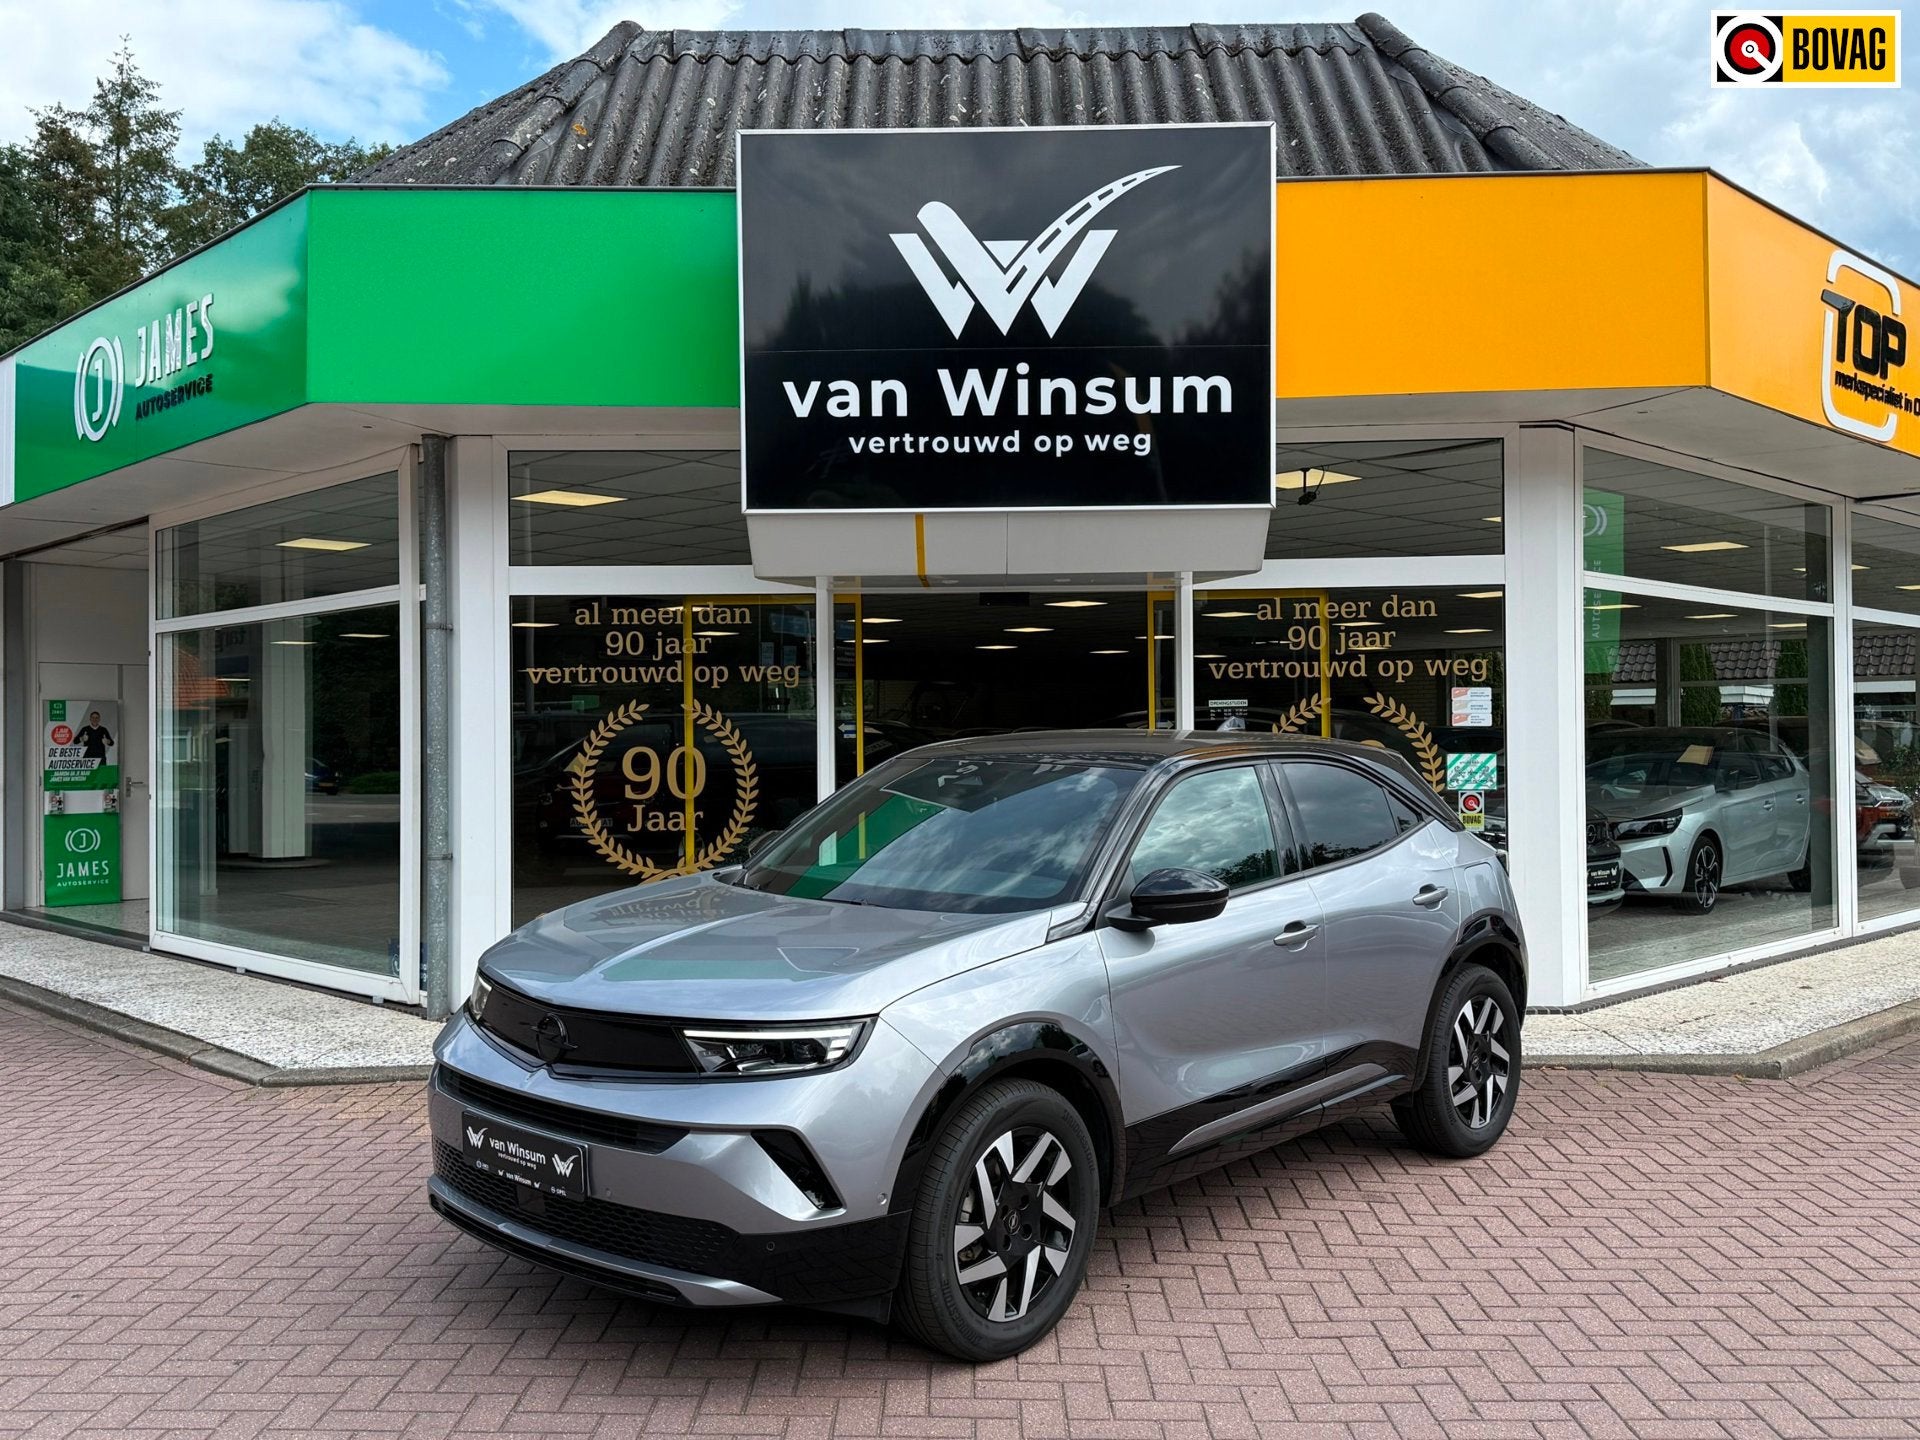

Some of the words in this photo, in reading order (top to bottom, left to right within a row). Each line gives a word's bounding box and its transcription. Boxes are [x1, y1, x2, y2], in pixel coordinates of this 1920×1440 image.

[135, 293, 215, 389] JAMES
[1821, 289, 1907, 380] TOP
[135, 374, 214, 421] AUTOSERVICE
[783, 377, 909, 419] van
[937, 362, 1233, 417] Winsum
[1835, 370, 1904, 409] merkspecialist
[849, 430, 1021, 455] vertrouwd
[1033, 432, 1074, 459] op
[1083, 431, 1152, 457] weg
[1256, 597, 1283, 621] al
[1293, 599, 1372, 620] meer
[1381, 594, 1439, 619] dan
[1591, 560, 1602, 638] AUTOSECE
[574, 602, 601, 626] al
[611, 606, 687, 626] meer
[698, 602, 752, 625] dan
[605, 631, 645, 656] 90
[653, 631, 712, 661] jaar
[1287, 626, 1326, 652] 90
[1335, 626, 1396, 656] jaar
[526, 660, 684, 685] vertrouwd
[694, 664, 729, 689] op
[738, 664, 801, 689] weg
[1208, 654, 1367, 680] vertrouwd
[1378, 660, 1415, 684] op
[1424, 657, 1489, 682] weg
[48, 748, 60, 758] DE
[59, 747, 82, 758] BESTE
[48, 759, 96, 770] AUTOSERVICE
[621, 746, 707, 801] 90
[627, 804, 704, 833] Jaar
[1462, 815, 1482, 824] BOVAG
[57, 861, 109, 878] JAMES
[57, 878, 110, 887] AUTOSERVICE
[489, 1138, 505, 1151] van
[508, 1142, 546, 1165] Winsum
[514, 1173, 532, 1186] Winsum
